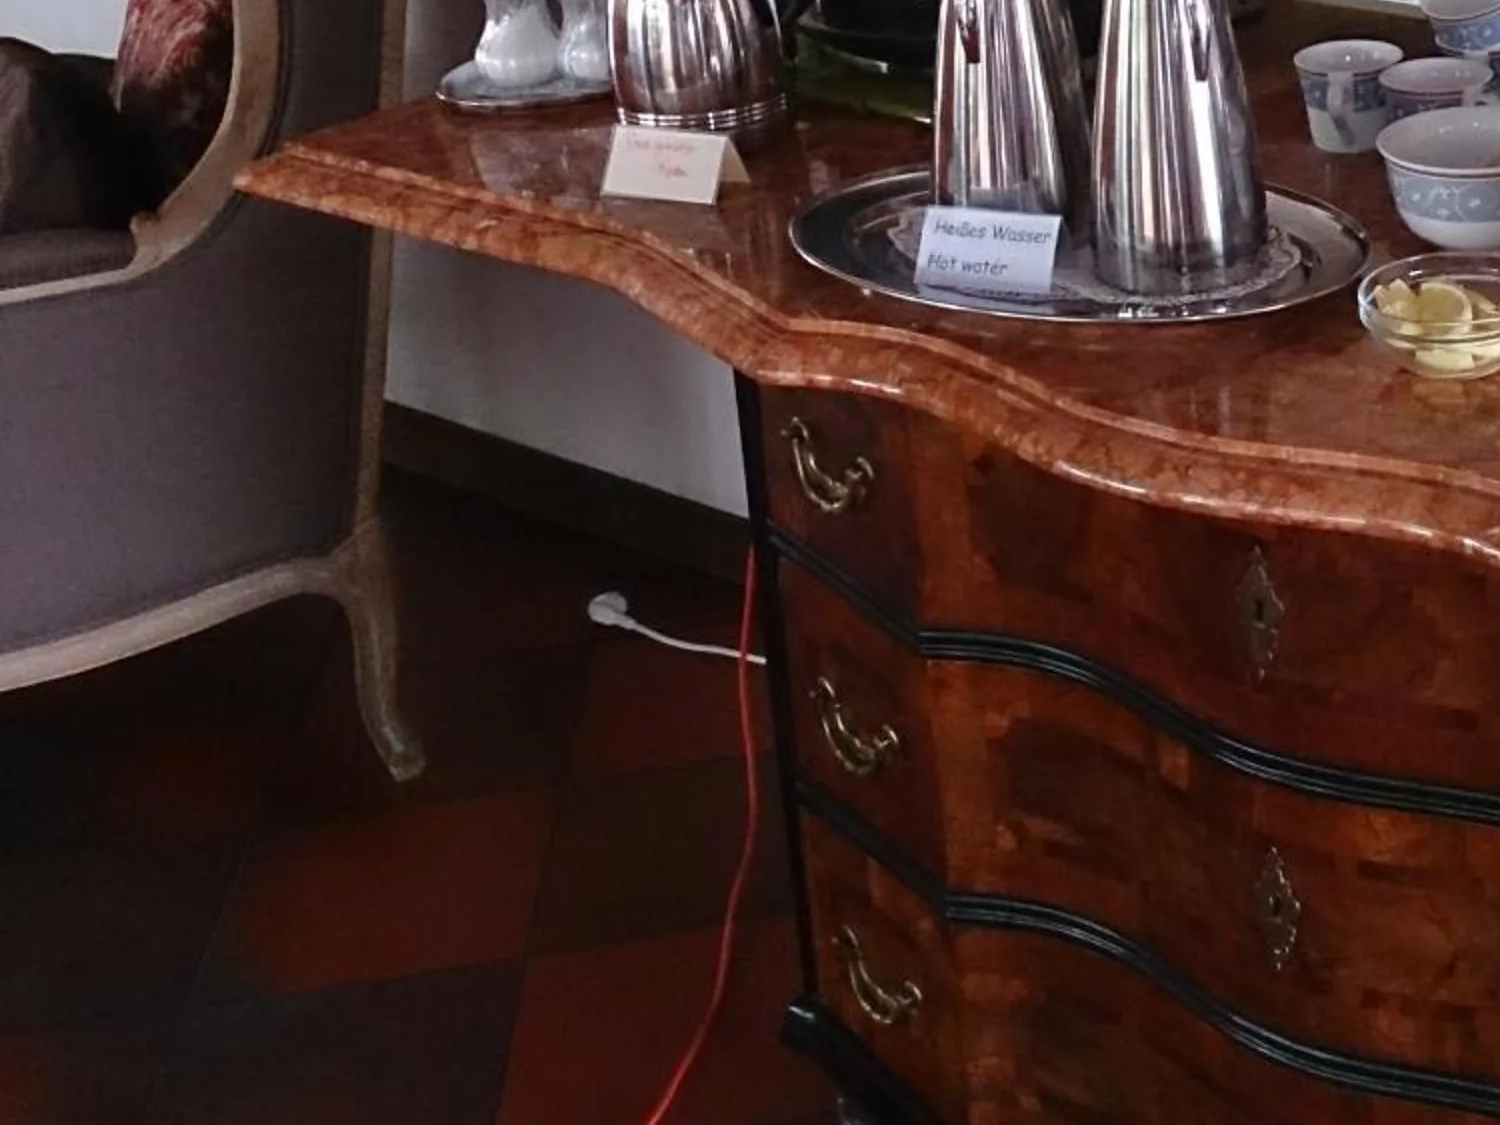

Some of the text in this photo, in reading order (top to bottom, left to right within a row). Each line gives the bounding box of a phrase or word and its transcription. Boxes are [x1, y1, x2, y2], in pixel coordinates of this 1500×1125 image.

[933, 219, 1053, 244] Heißes Wasser
[927, 251, 1008, 276] Hot water
